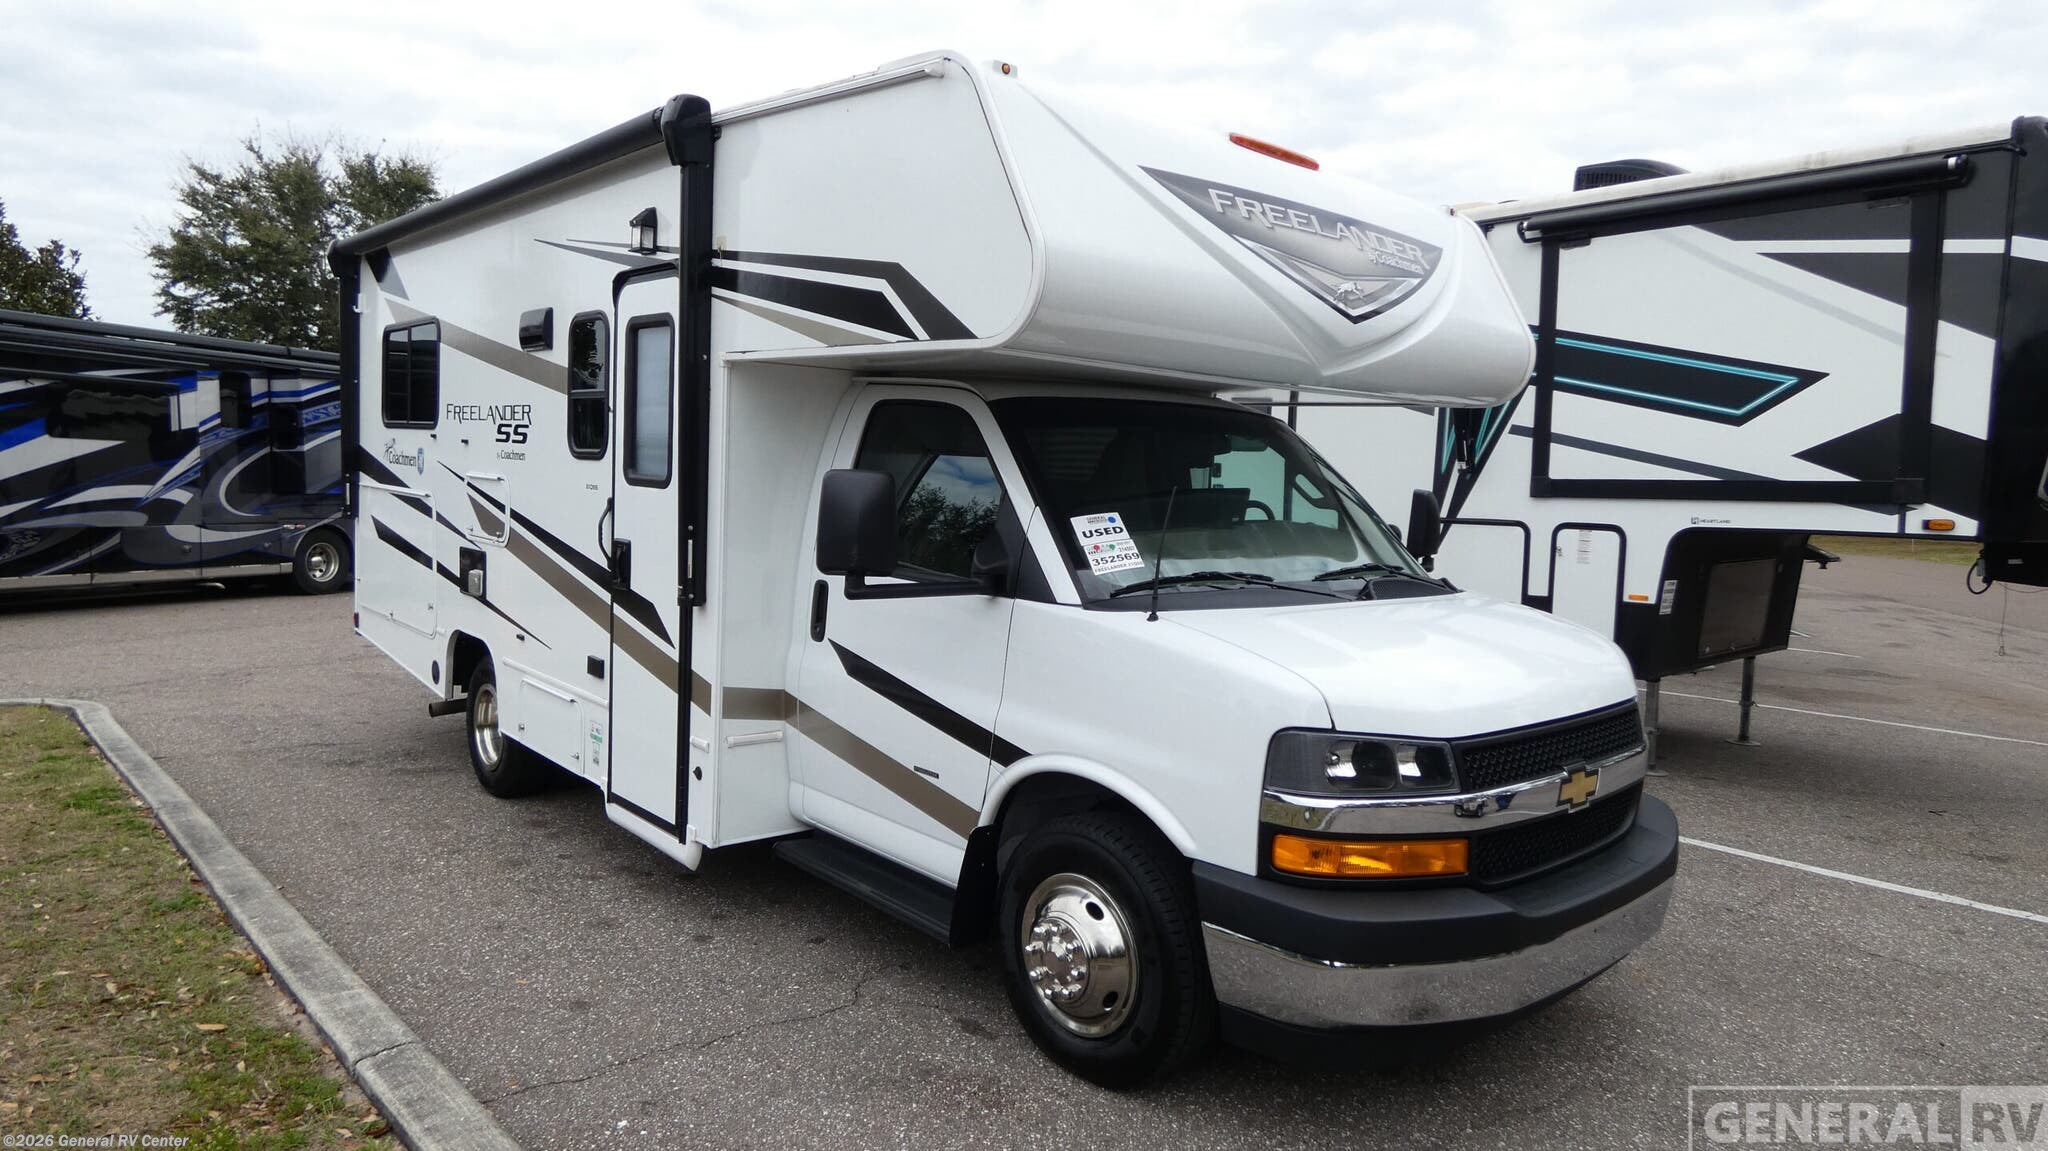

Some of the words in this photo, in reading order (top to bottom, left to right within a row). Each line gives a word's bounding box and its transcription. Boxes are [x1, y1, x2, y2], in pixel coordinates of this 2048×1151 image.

[1208, 188, 1430, 271] FREELANDER
[446, 403, 532, 425] FREELANDER
[495, 423, 529, 444] SS
[500, 449, 526, 461] Coachmen
[1082, 526, 1124, 539] USED
[1092, 552, 1140, 566] 352569
